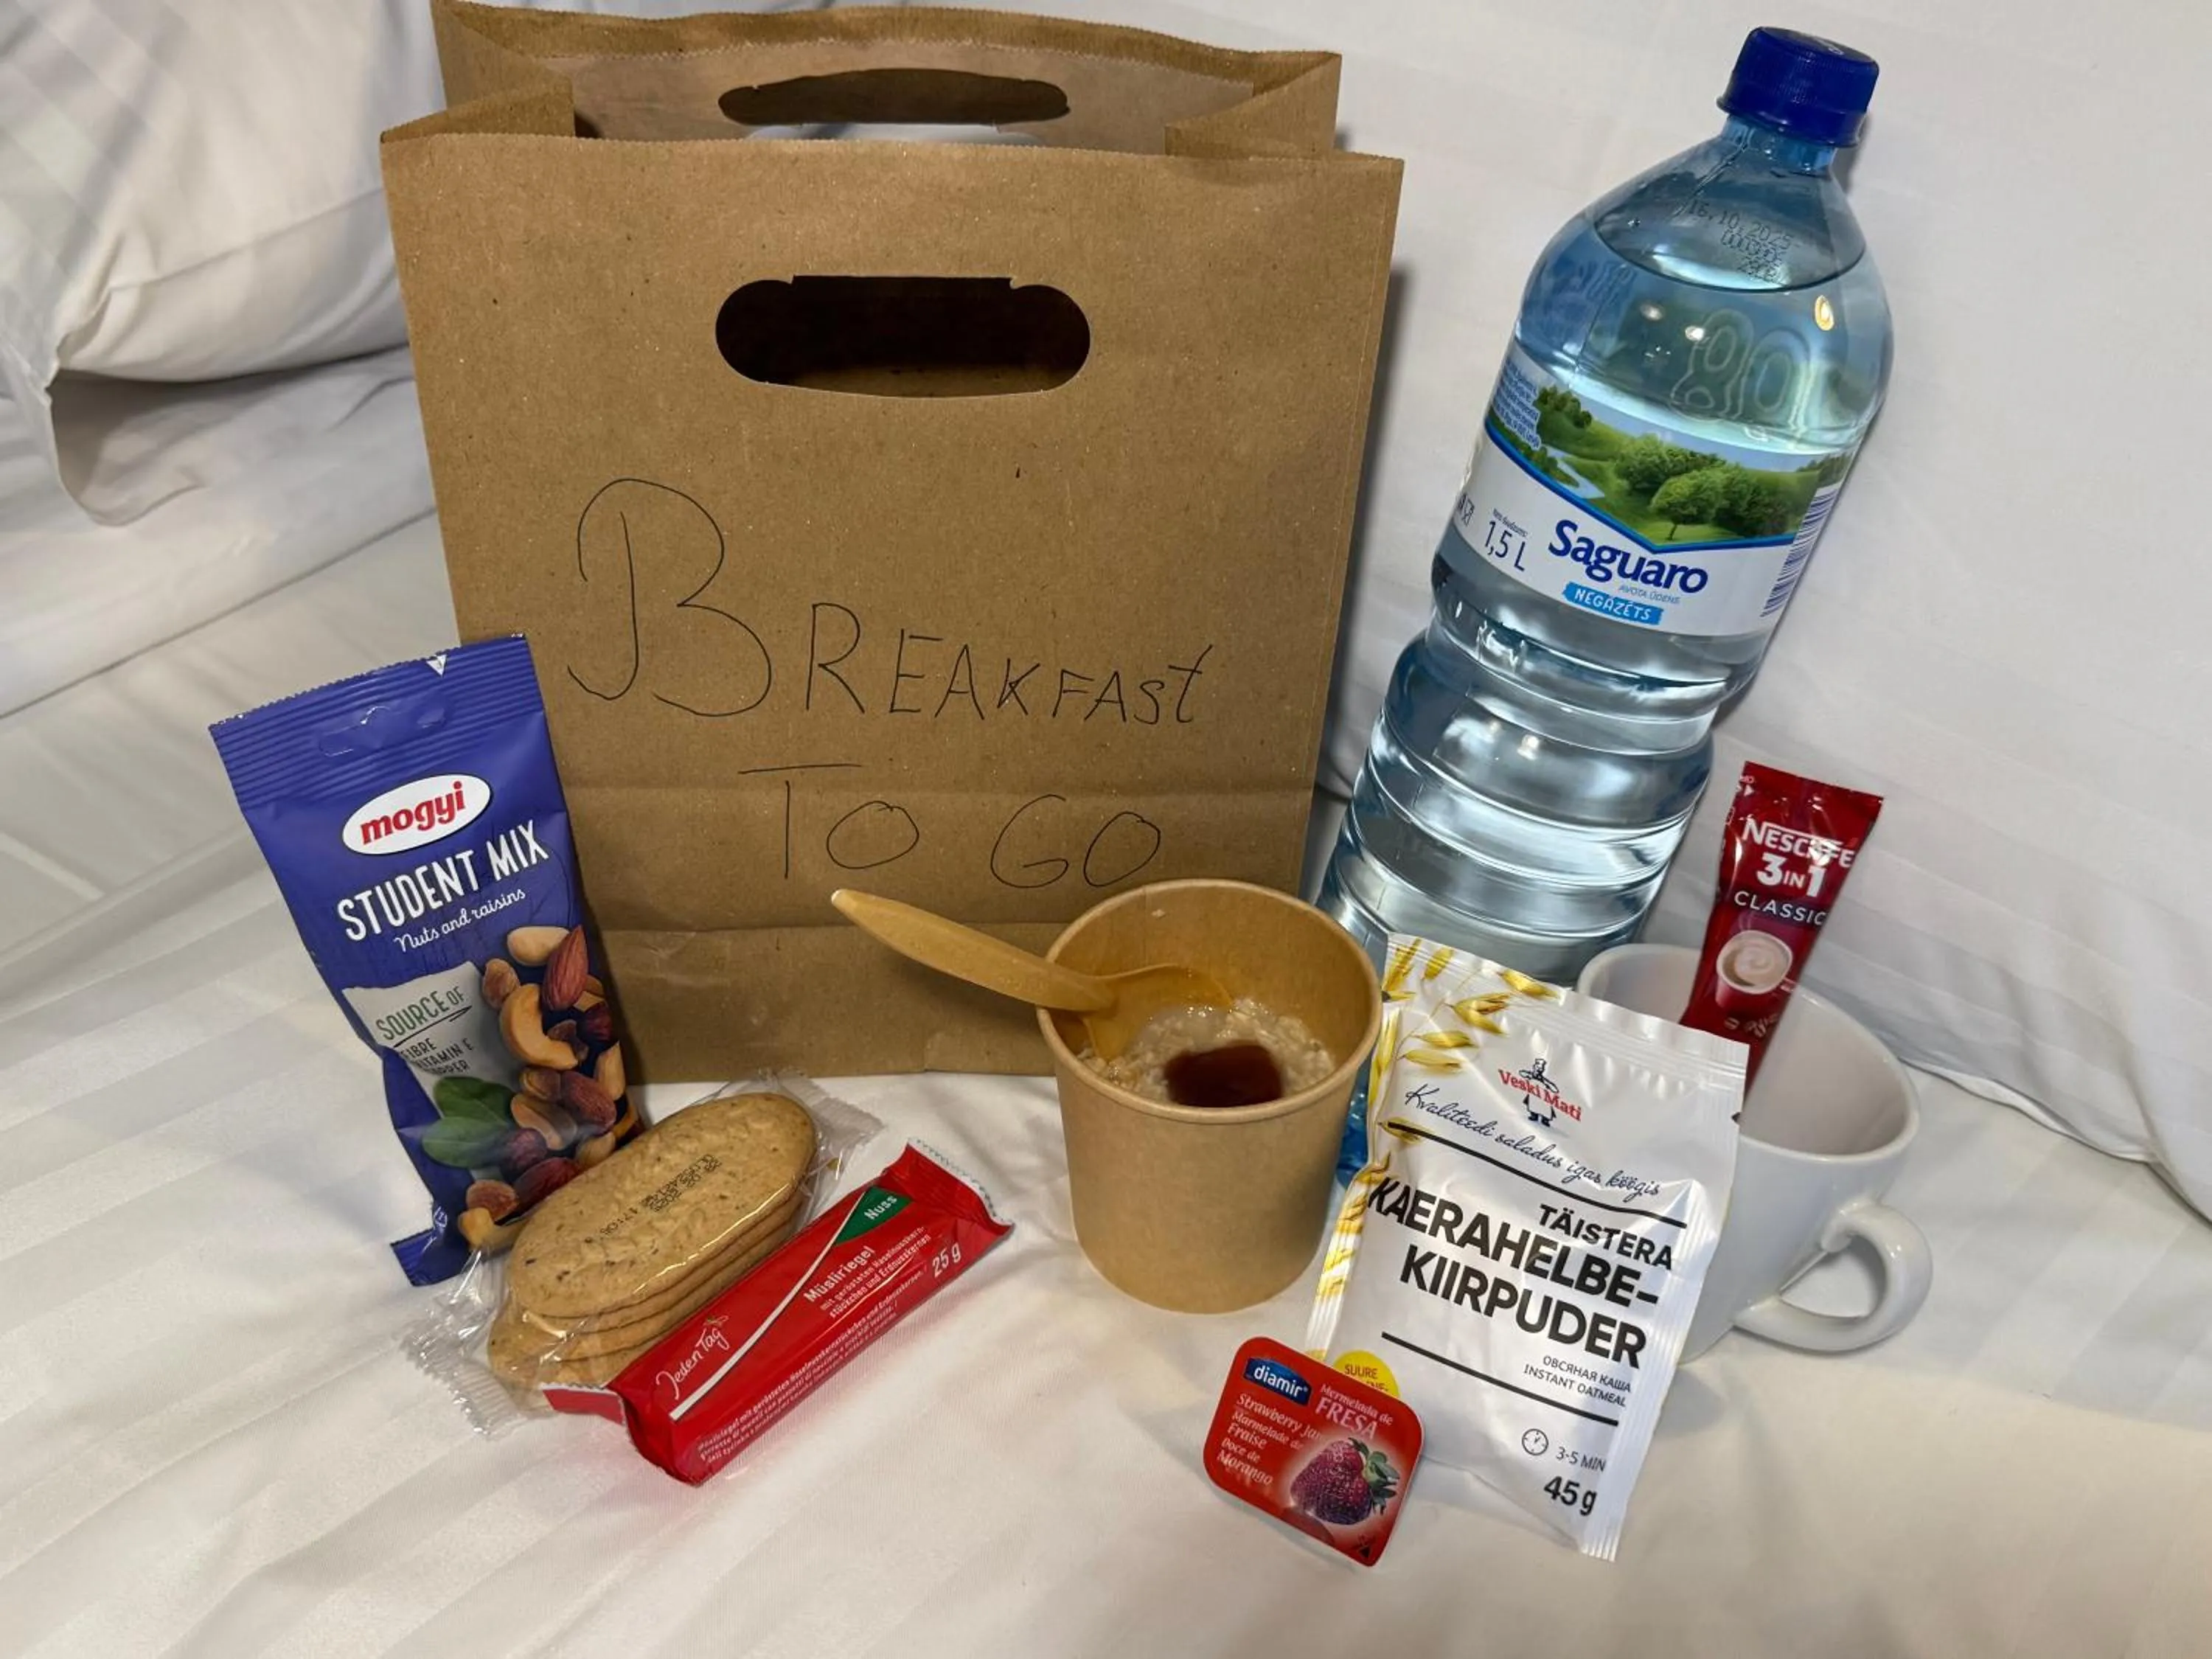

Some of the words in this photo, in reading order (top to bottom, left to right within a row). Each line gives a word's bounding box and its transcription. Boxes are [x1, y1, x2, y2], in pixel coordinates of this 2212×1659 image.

[1484, 521, 1514, 558] 1,5
[1513, 541, 1526, 572] L
[1548, 518, 1709, 594] Saguaro
[360, 780, 467, 845] mogyi
[738, 762, 919, 878] TO
[990, 794, 1161, 888] GO
[337, 849, 483, 942] STUDENT
[485, 818, 549, 882] MIX
[393, 927, 440, 953] Nuts
[441, 907, 471, 936] and
[471, 888, 526, 919] raisins
[1733, 890, 1827, 926] CLASSIC
[376, 990, 450, 1041] SOURCE
[445, 986, 469, 1008] OF
[1498, 1068, 1540, 1098] Veski
[1543, 1088, 1582, 1121] Mati
[1405, 1083, 1498, 1137] Kvaliteedi
[1495, 1135, 1561, 1169] saladus
[1561, 1161, 1601, 1185] igas
[1604, 1169, 1660, 1203] köögis
[863, 1194, 898, 1221] Nuss
[1368, 1176, 1660, 1308] KAERAHELBE-
[1539, 1203, 1674, 1271] TÄISTERA
[803, 1245, 876, 1303] Müsliriegel
[932, 1247, 950, 1279] 25
[951, 1242, 962, 1263] g
[1399, 1243, 1647, 1370] KIIRPUDER
[655, 1349, 704, 1400] Jeden
[694, 1326, 730, 1351] Tag
[1253, 1364, 1303, 1398] diamir
[1344, 1363, 1378, 1380] SUURE
[1523, 1363, 1576, 1391] INSTANT
[1576, 1382, 1627, 1408] OATMEAL
[1543, 1354, 1598, 1382] ОВСЯНАЯ
[1599, 1371, 1632, 1394] КАША
[1237, 1392, 1303, 1434] Strawberry
[1315, 1396, 1379, 1440] FRESA
[1320, 1383, 1379, 1418] Mermelada
[1378, 1412, 1394, 1426] de
[1220, 1436, 1247, 1455] Doce
[1247, 1450, 1262, 1464] de
[1227, 1422, 1267, 1450] Fraise
[1217, 1449, 1274, 1486] Morango
[1556, 1446, 1579, 1465] 3-5
[1580, 1454, 1607, 1472] MIN
[1543, 1475, 1581, 1506] 45
[1579, 1489, 1598, 1517] g
